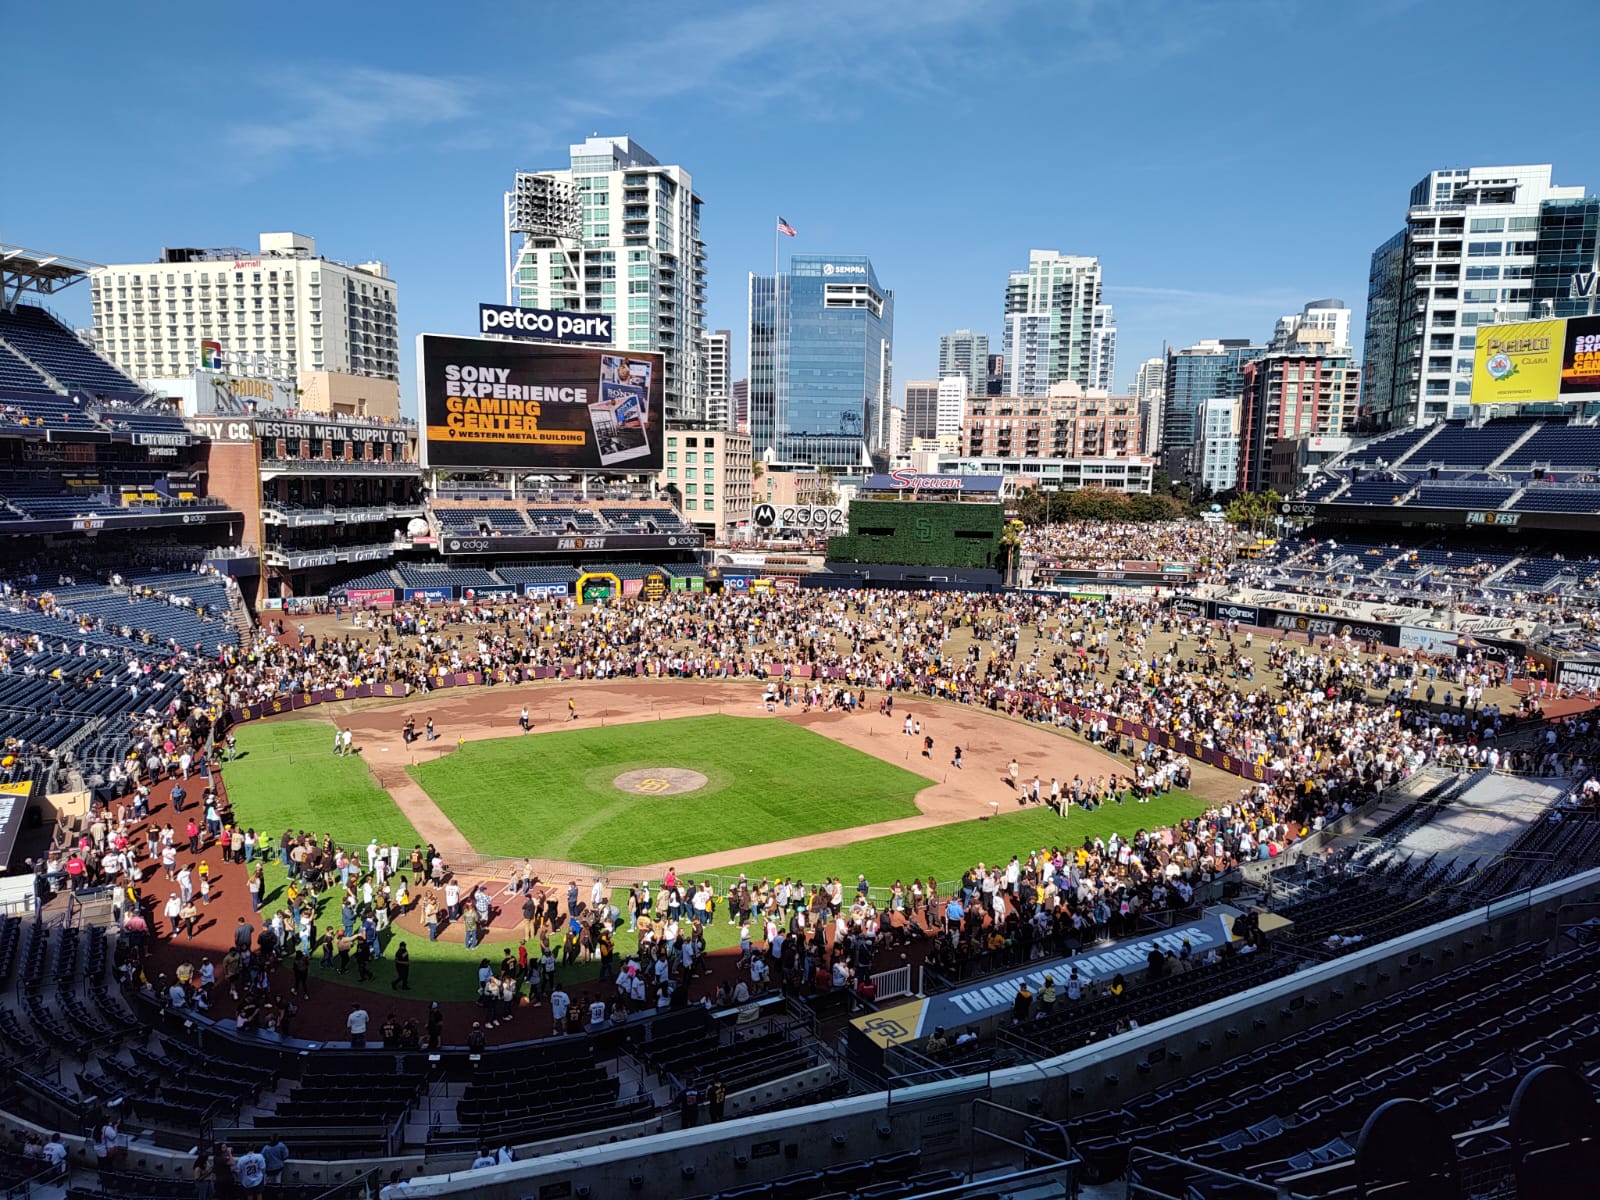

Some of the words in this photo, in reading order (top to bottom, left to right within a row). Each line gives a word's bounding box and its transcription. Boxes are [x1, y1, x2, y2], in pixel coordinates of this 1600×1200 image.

[835, 266, 865, 274] SEMPRA
[482, 308, 553, 332] petco
[557, 316, 609, 337] park
[445, 365, 510, 384] SONY
[232, 379, 274, 401] PADRES
[446, 381, 587, 403] EXPERIENCE
[446, 397, 541, 417] GAMING
[447, 413, 537, 431] CENTER
[228, 422, 253, 440] CO.
[255, 421, 310, 438] WESTERN
[315, 426, 349, 440] METAL
[352, 428, 388, 442] SUPPLY
[392, 430, 408, 443] CO.
[458, 431, 505, 440] WESTERN
[507, 433, 537, 441] METAL
[539, 434, 583, 442] BUILDING
[890, 468, 964, 494] Sycuan
[782, 503, 842, 530] edge
[1292, 504, 1316, 515] edge
[1495, 513, 1521, 525] FEST
[462, 540, 488, 551] edge
[583, 538, 606, 549] FEST
[678, 536, 700, 547] edge
[527, 586, 566, 595] GEICO
[1342, 601, 1361, 610] DECK
[1308, 620, 1336, 633] FEST
[1354, 627, 1382, 638] edge
[1564, 662, 1593, 672] HUNGRY
[949, 975, 1029, 1014] THANK
[1028, 963, 1082, 990] YOU
[1074, 941, 1155, 977] PADRES
[1151, 927, 1214, 953] FANS
[863, 1018, 908, 1038] SD
